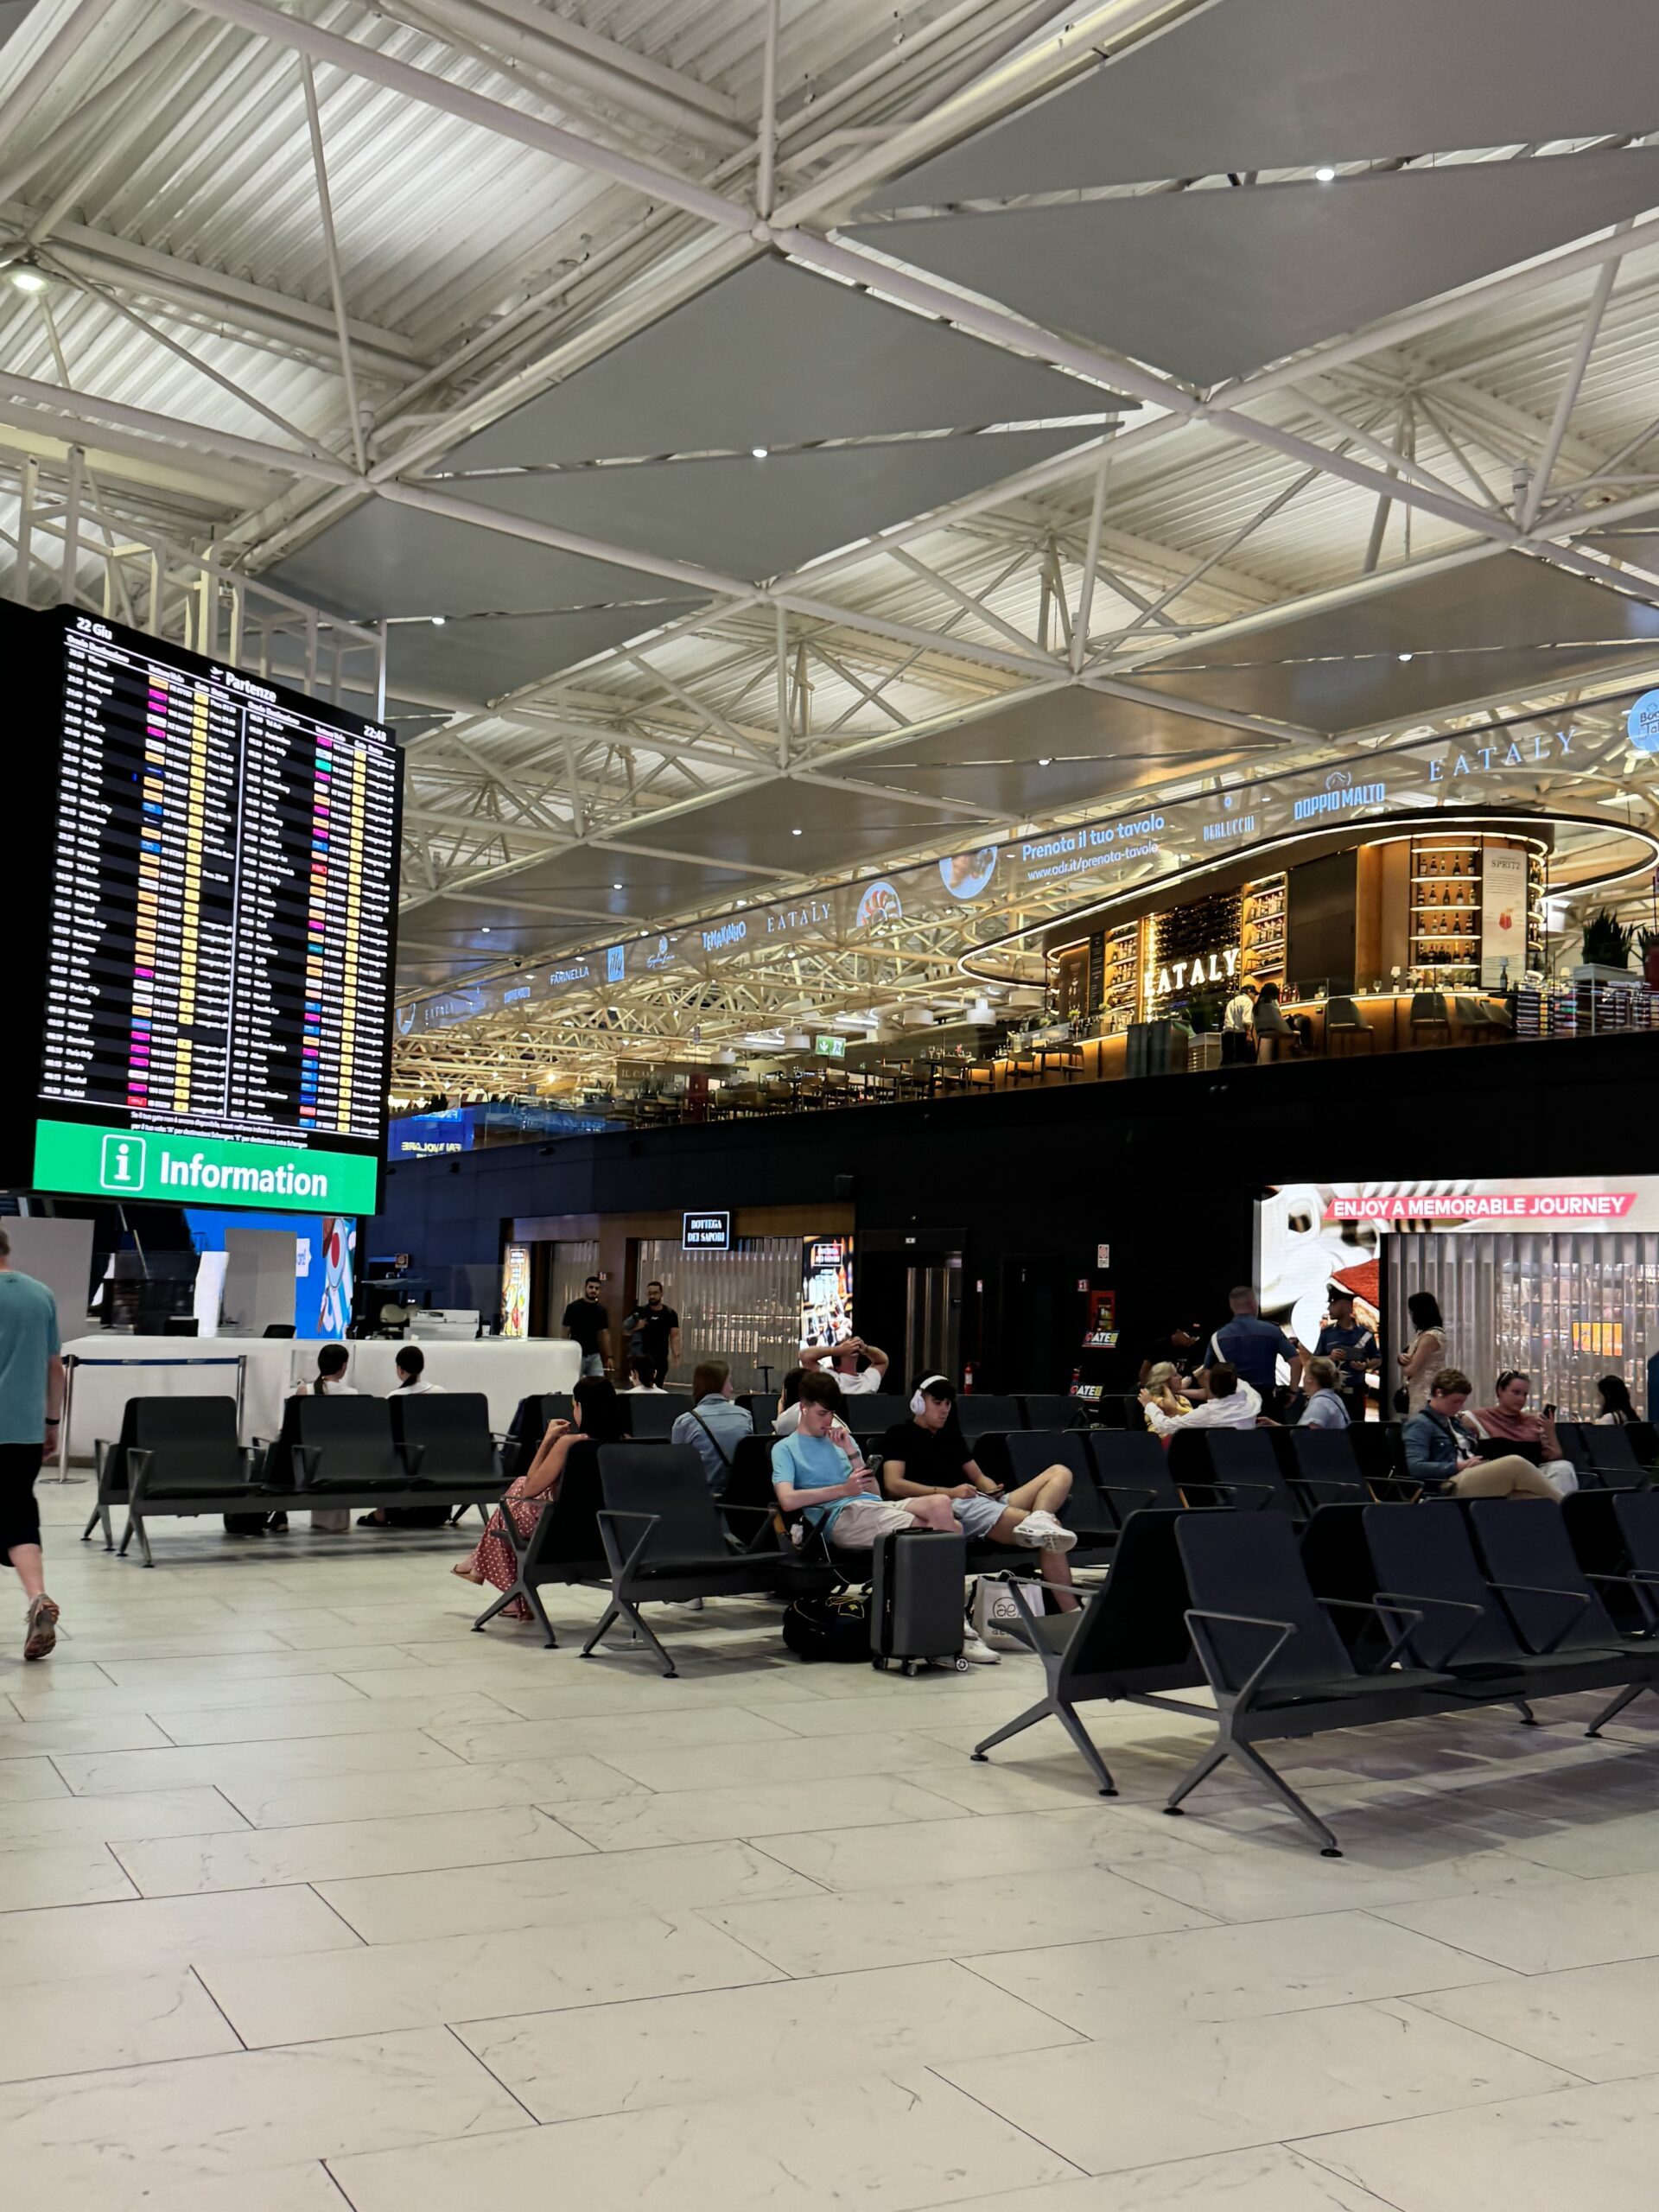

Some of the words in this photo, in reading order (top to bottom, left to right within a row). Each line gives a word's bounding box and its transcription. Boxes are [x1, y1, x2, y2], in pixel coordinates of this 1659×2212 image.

[76, 616, 92, 632] 22
[91, 623, 113, 641] Giu
[225, 671, 277, 703] Partenze
[362, 724, 387, 743] 22:48
[1641, 719, 1659, 735] Ta
[1429, 730, 1578, 783] EATALY
[1294, 790, 1340, 821] DOPPIO
[1341, 783, 1385, 808] MALTO
[1022, 836, 1075, 861] Prenota
[1078, 830, 1086, 849] il
[1090, 829, 1115, 846] tuo
[1117, 813, 1165, 839] tavolo
[766, 902, 830, 934] EATALY
[550, 966, 589, 986] FARINELLA
[1142, 948, 1240, 998] EATALY
[160, 1152, 328, 1198] Information
[1333, 1199, 1389, 1217] ENJOY
[1391, 1199, 1405, 1216] A
[1408, 1197, 1526, 1217] MEMORABLE
[1529, 1196, 1626, 1215] JOURNEY
[687, 1232, 700, 1243] DEI
[690, 1219, 722, 1230] BOTTEGA
